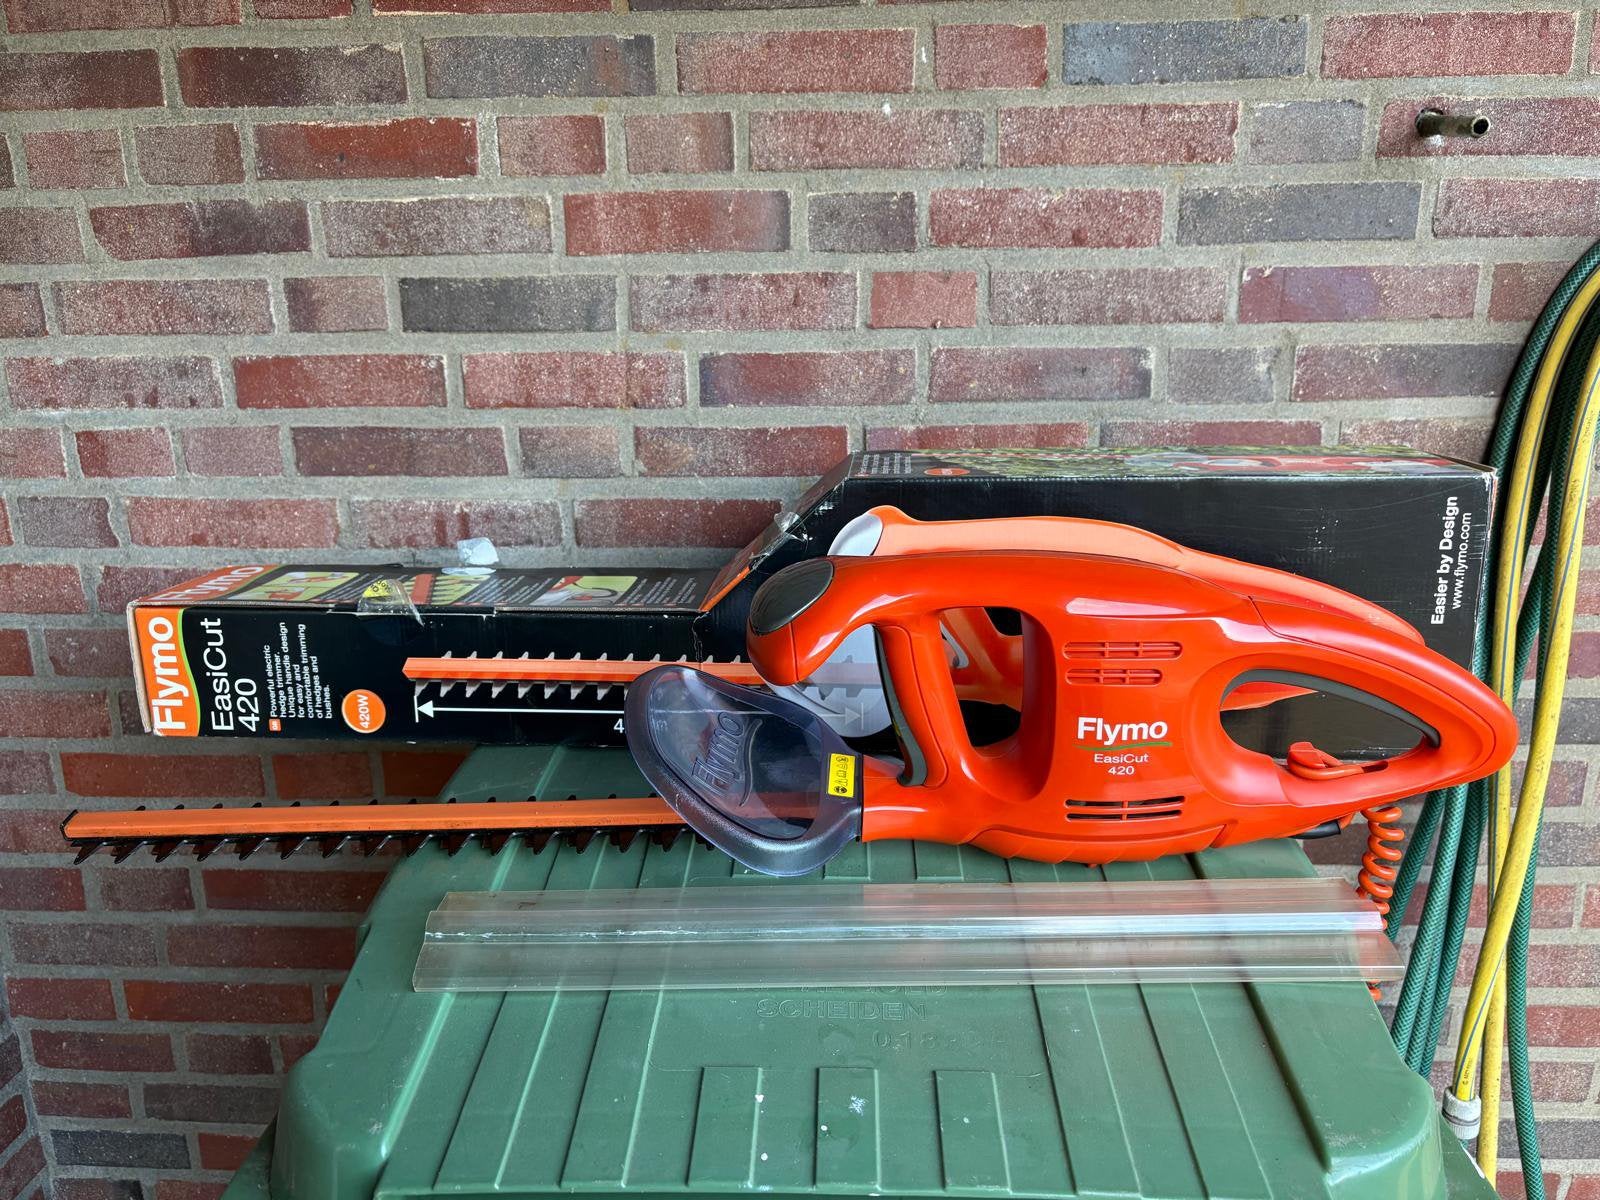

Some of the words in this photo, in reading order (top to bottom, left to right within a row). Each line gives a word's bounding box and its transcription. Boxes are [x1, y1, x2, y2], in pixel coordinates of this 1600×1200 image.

[1438, 496, 1459, 550] Design
[1437, 554, 1453, 573] by
[1452, 512, 1472, 609] www.flymo.com
[147, 567, 264, 600] Flymo
[1430, 577, 1448, 624] Easier
[279, 622, 288, 653] design
[298, 623, 308, 664] trimming
[148, 616, 190, 730] Flymo
[200, 617, 235, 730] EasiCut
[263, 645, 273, 677] electric
[274, 651, 284, 688] trimmer.
[283, 654, 292, 685] handle
[292, 664, 301, 681] and
[309, 656, 319, 673] and
[234, 678, 260, 732] 420
[266, 679, 278, 717] Powerful
[278, 690, 287, 718] hedge
[287, 686, 296, 718] Unique
[295, 683, 304, 704] easy
[302, 666, 314, 719] comfortable
[313, 674, 323, 708] hedges
[323, 685, 332, 719] bushes.
[297, 705, 305, 718] for
[315, 710, 323, 719] of
[357, 694, 370, 728] 420W
[1077, 716, 1168, 746] Flymo
[1093, 753, 1149, 764] EasiCut
[1108, 766, 1135, 775] 420
[756, 999, 929, 1021] SCHEIDEN
